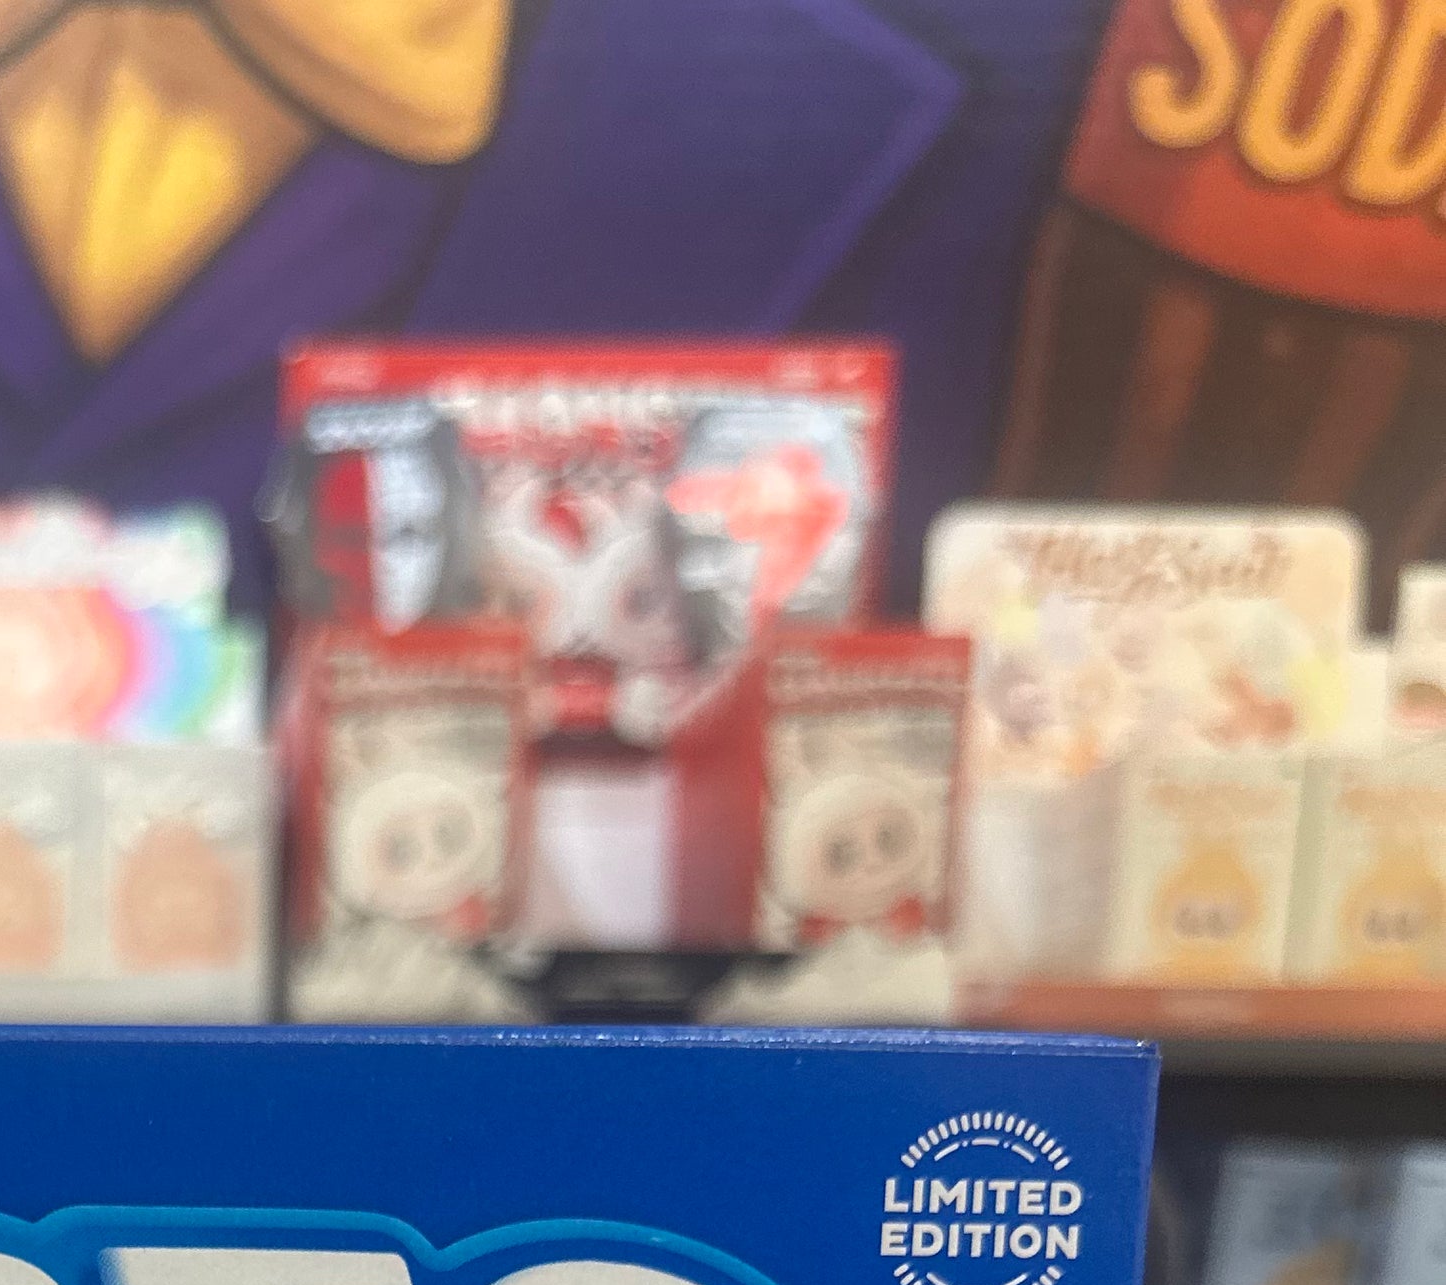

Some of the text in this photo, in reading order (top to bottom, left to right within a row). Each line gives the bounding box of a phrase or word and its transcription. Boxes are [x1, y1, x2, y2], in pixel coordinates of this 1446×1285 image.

[1127, 0, 1446, 215] SOD
[884, 1177, 1083, 1216] LIMITED
[880, 1222, 1080, 1260] EDITION
